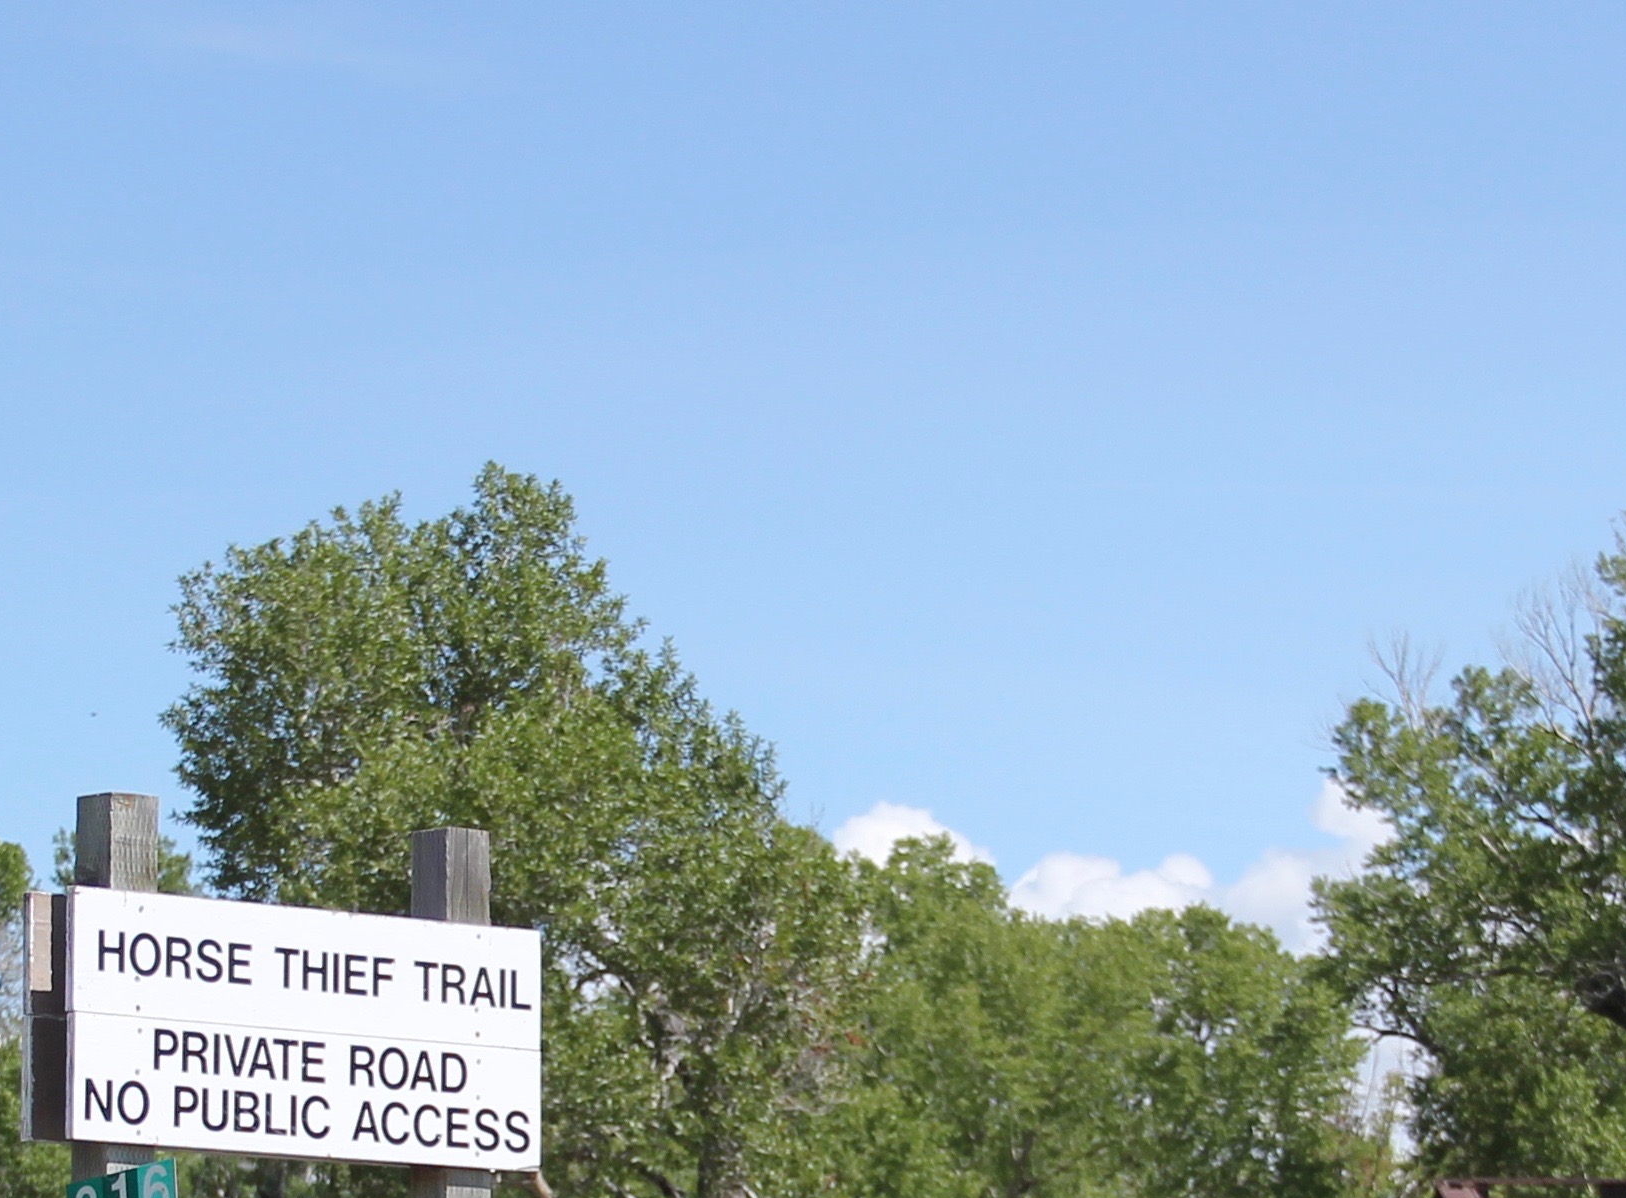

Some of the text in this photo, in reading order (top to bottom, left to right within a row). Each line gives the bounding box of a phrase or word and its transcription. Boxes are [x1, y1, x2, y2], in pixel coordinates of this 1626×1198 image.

[98, 929, 532, 1010] HORSE THIEF TRAIL
[153, 1028, 467, 1093] PRIVATE ROAD
[84, 1078, 530, 1153] NO PUBLIC ACCESS
